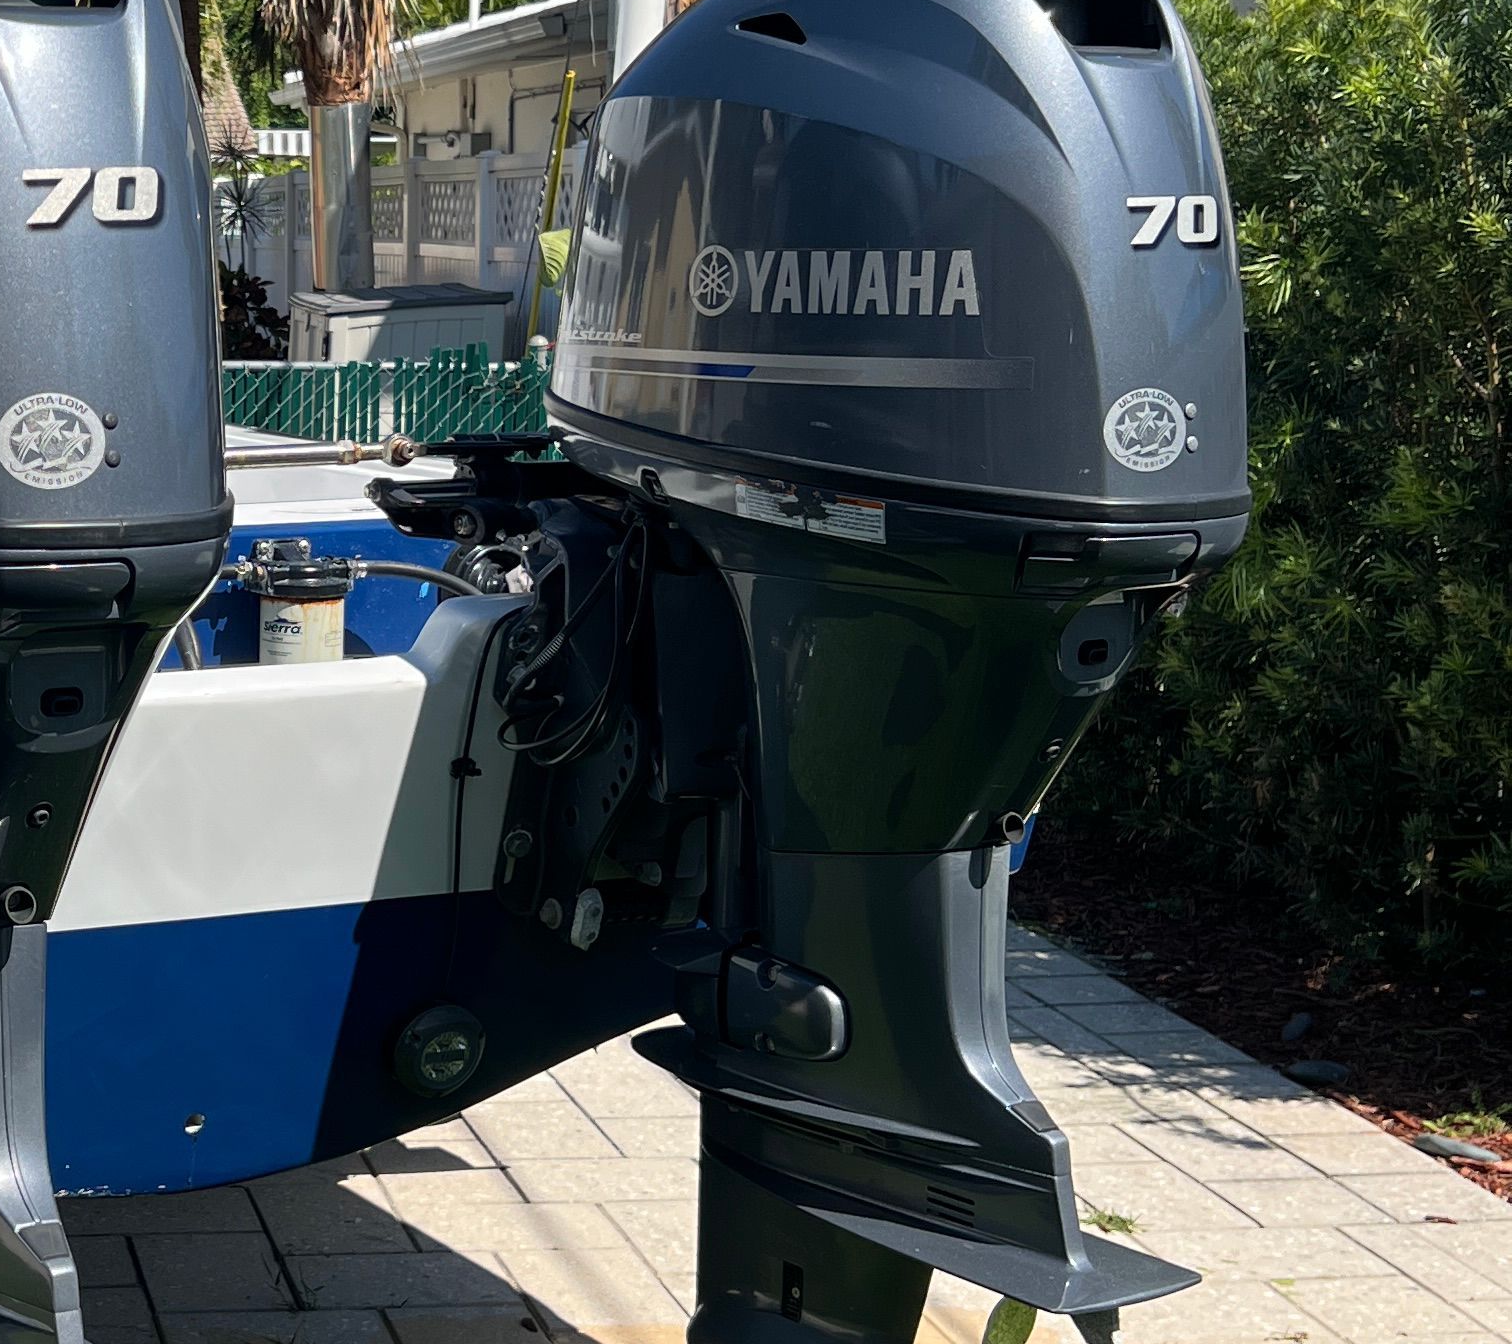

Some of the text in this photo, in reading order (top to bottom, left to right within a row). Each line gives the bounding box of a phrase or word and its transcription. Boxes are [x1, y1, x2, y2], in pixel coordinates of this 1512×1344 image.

[21, 166, 160, 226] 70
[1126, 195, 1218, 246] 70
[744, 249, 980, 316] YAMAHA
[24, 471, 83, 485] EMISSION
[264, 620, 302, 634] Sierra
